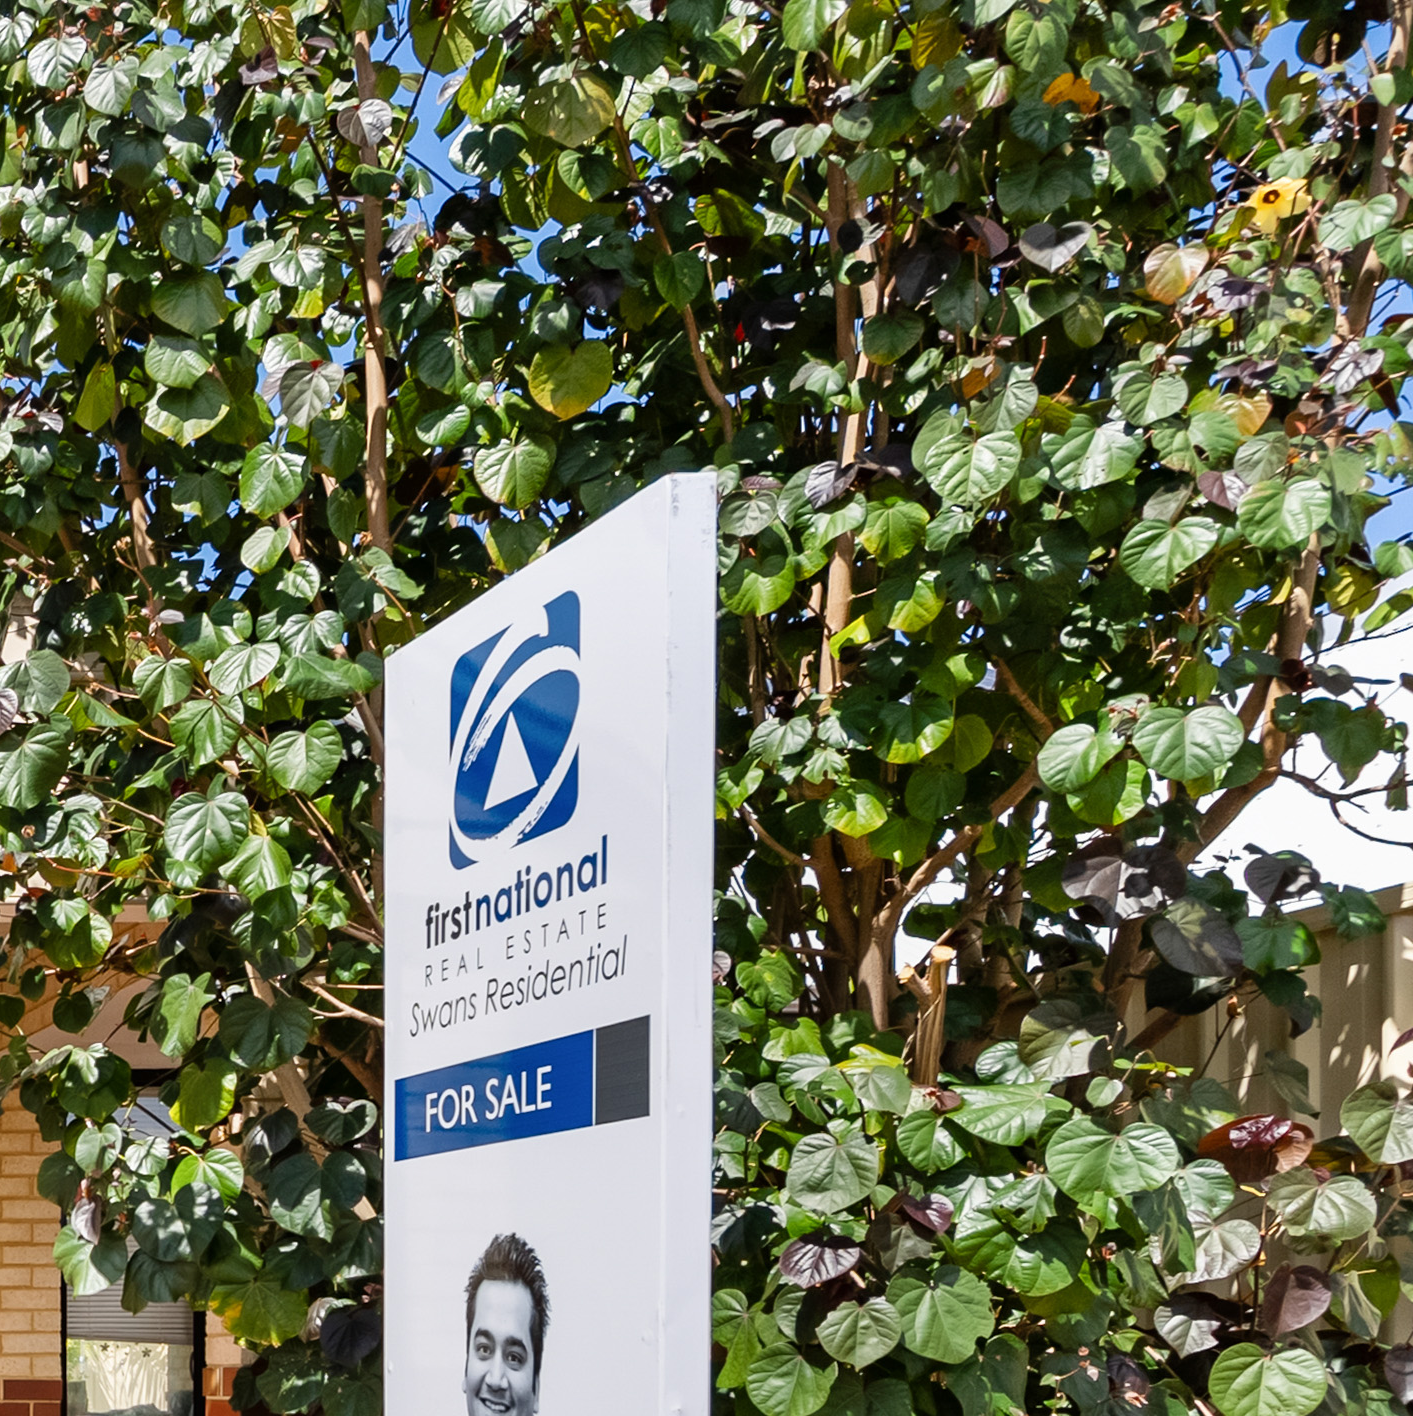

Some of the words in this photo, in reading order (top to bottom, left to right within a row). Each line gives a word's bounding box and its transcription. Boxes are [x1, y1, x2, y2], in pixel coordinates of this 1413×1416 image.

[424, 834, 609, 950] firstnational
[409, 992, 478, 1038] Swans
[485, 934, 629, 1016] Residential
[424, 947, 485, 987] REAL
[505, 903, 608, 960] ESTATE
[424, 1084, 479, 1134] FOR
[484, 1065, 553, 1119] SALE
